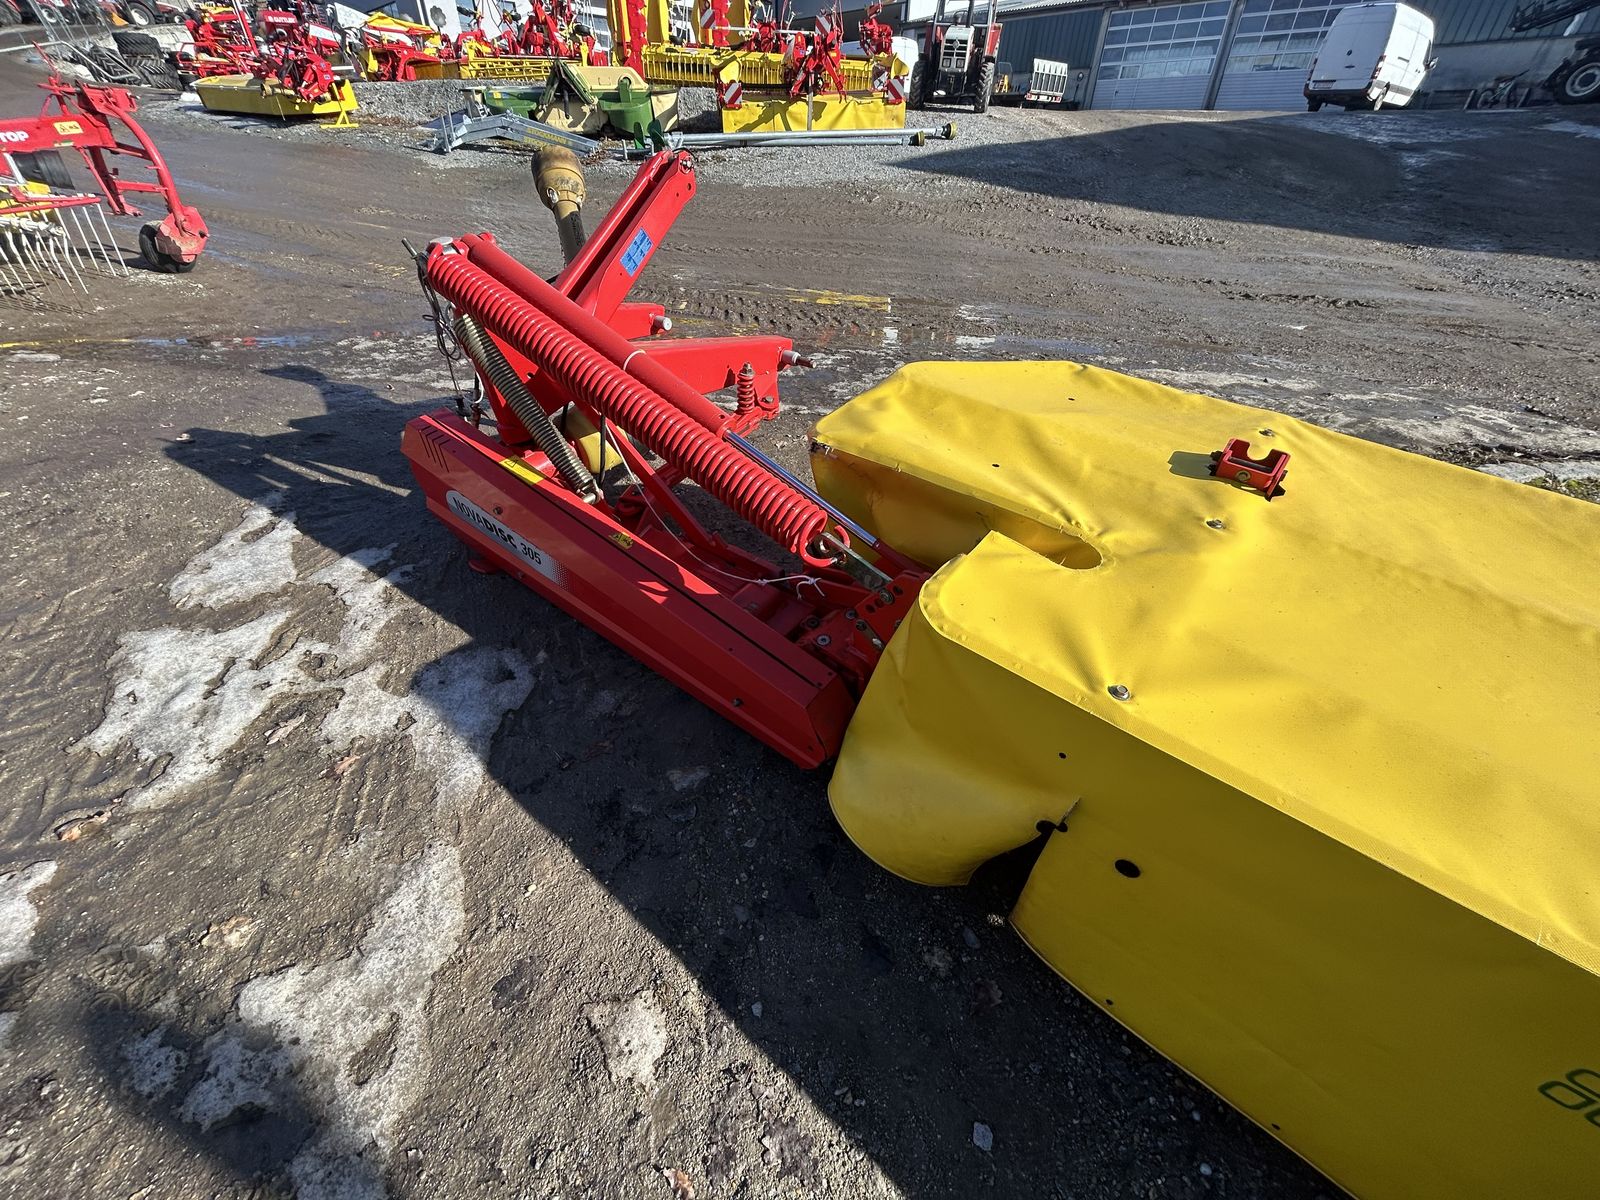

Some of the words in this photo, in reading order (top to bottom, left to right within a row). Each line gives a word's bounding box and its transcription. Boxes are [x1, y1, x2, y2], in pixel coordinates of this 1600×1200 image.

[0, 130, 30, 143] TOP
[452, 496, 517, 549] NOVADISC
[520, 542, 542, 565] 305
